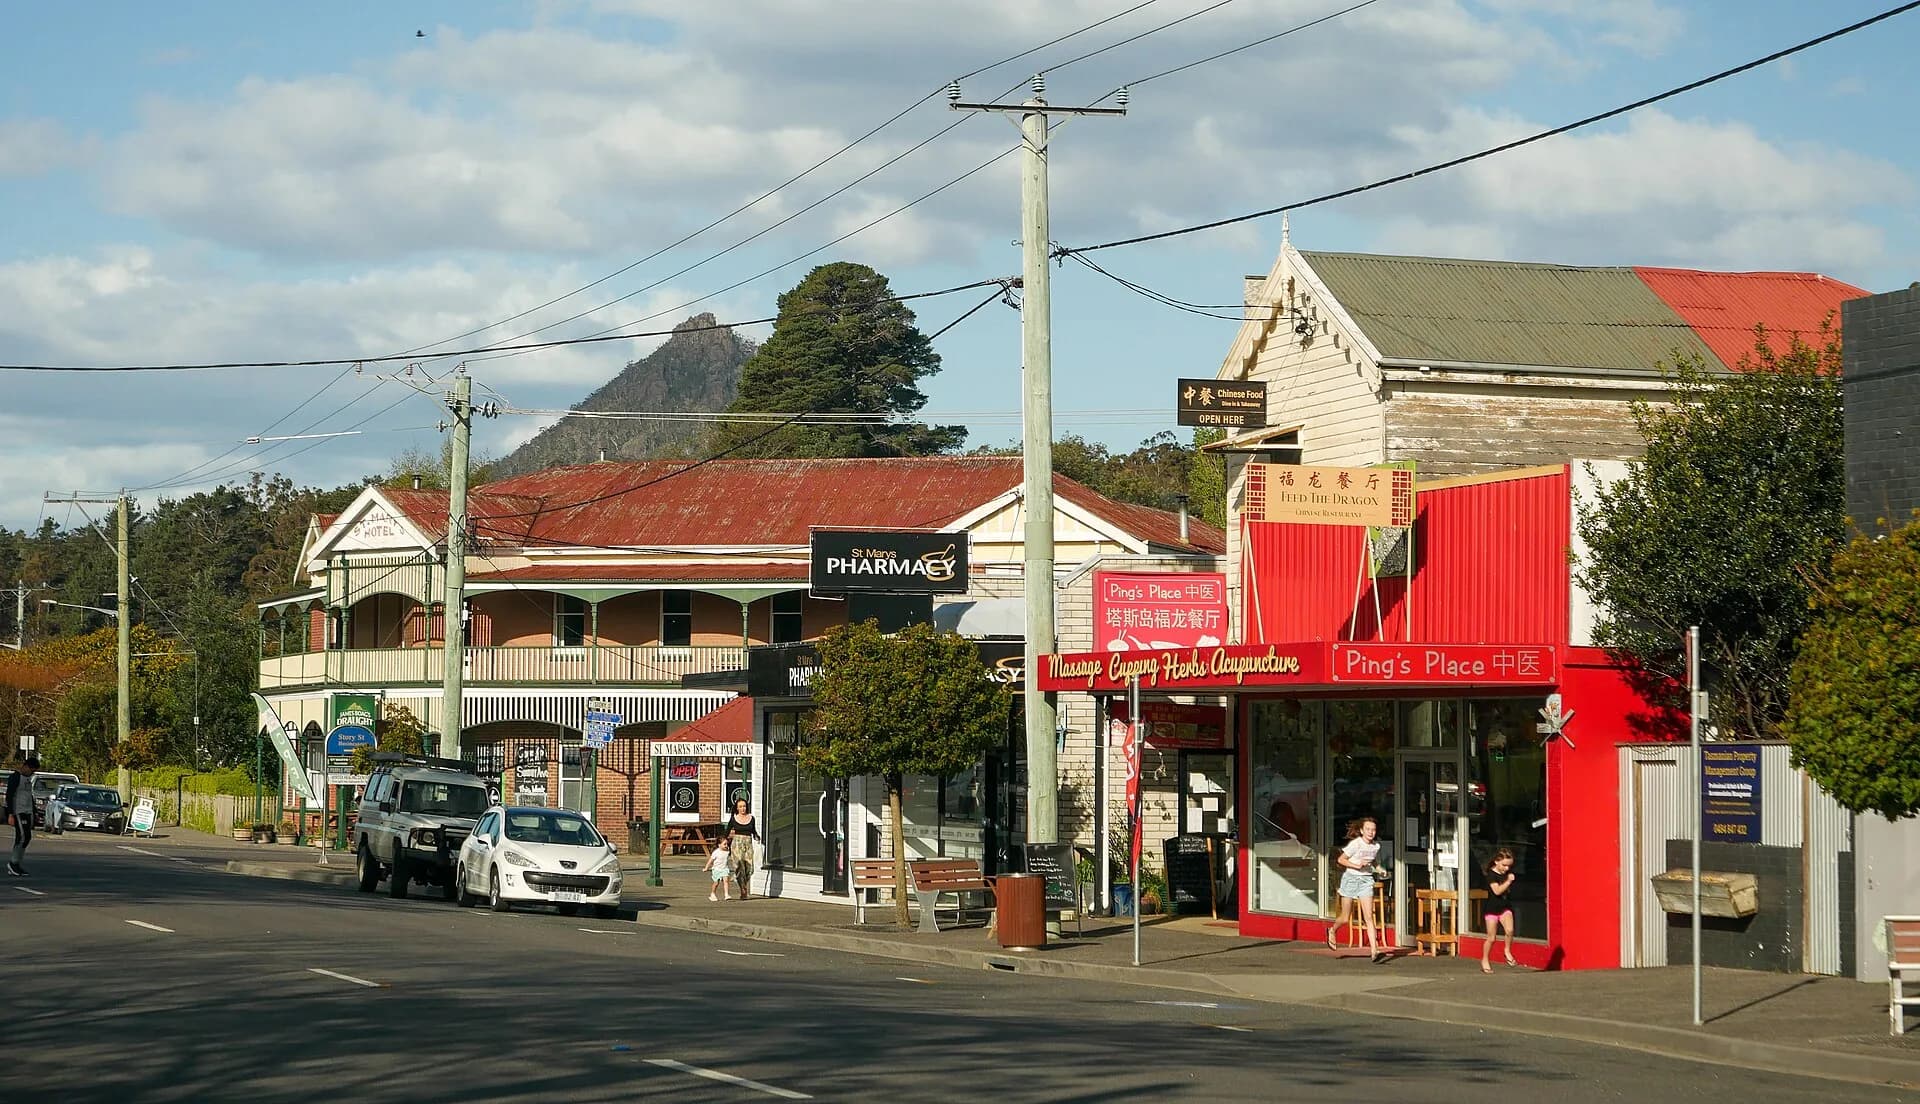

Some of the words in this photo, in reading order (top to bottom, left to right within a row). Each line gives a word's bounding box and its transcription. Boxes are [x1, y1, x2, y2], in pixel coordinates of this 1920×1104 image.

[1184, 386, 1215, 406] 中餐
[1218, 389, 1245, 398] Chinese
[1247, 390, 1264, 399] Food
[1200, 415, 1220, 423] OPEN
[1223, 415, 1244, 424] HERE
[364, 525, 394, 538] HOTEL
[851, 548, 864, 558] St
[866, 549, 897, 560] Marys
[827, 557, 957, 576] PHARMACY
[1110, 583, 1143, 600] Ping's
[1149, 584, 1182, 599] Place
[1185, 584, 1215, 599] 中医
[1106, 607, 1220, 629] 塔斯岛福龙餐厅
[1048, 653, 1103, 688] Massage
[1163, 651, 1208, 681] Herbs
[1211, 645, 1300, 684] Acupuncture
[1346, 650, 1411, 679] Ping's
[1425, 650, 1485, 677] Place
[1492, 649, 1541, 677] 中医
[337, 717, 374, 726] DRAUGHT
[654, 744, 663, 754] ST
[666, 744, 691, 754] MARYS
[1733, 751, 1757, 763] Property
[673, 765, 697, 776] OPEN
[1704, 765, 1739, 777] Management
[1740, 766, 1756, 778] Group
